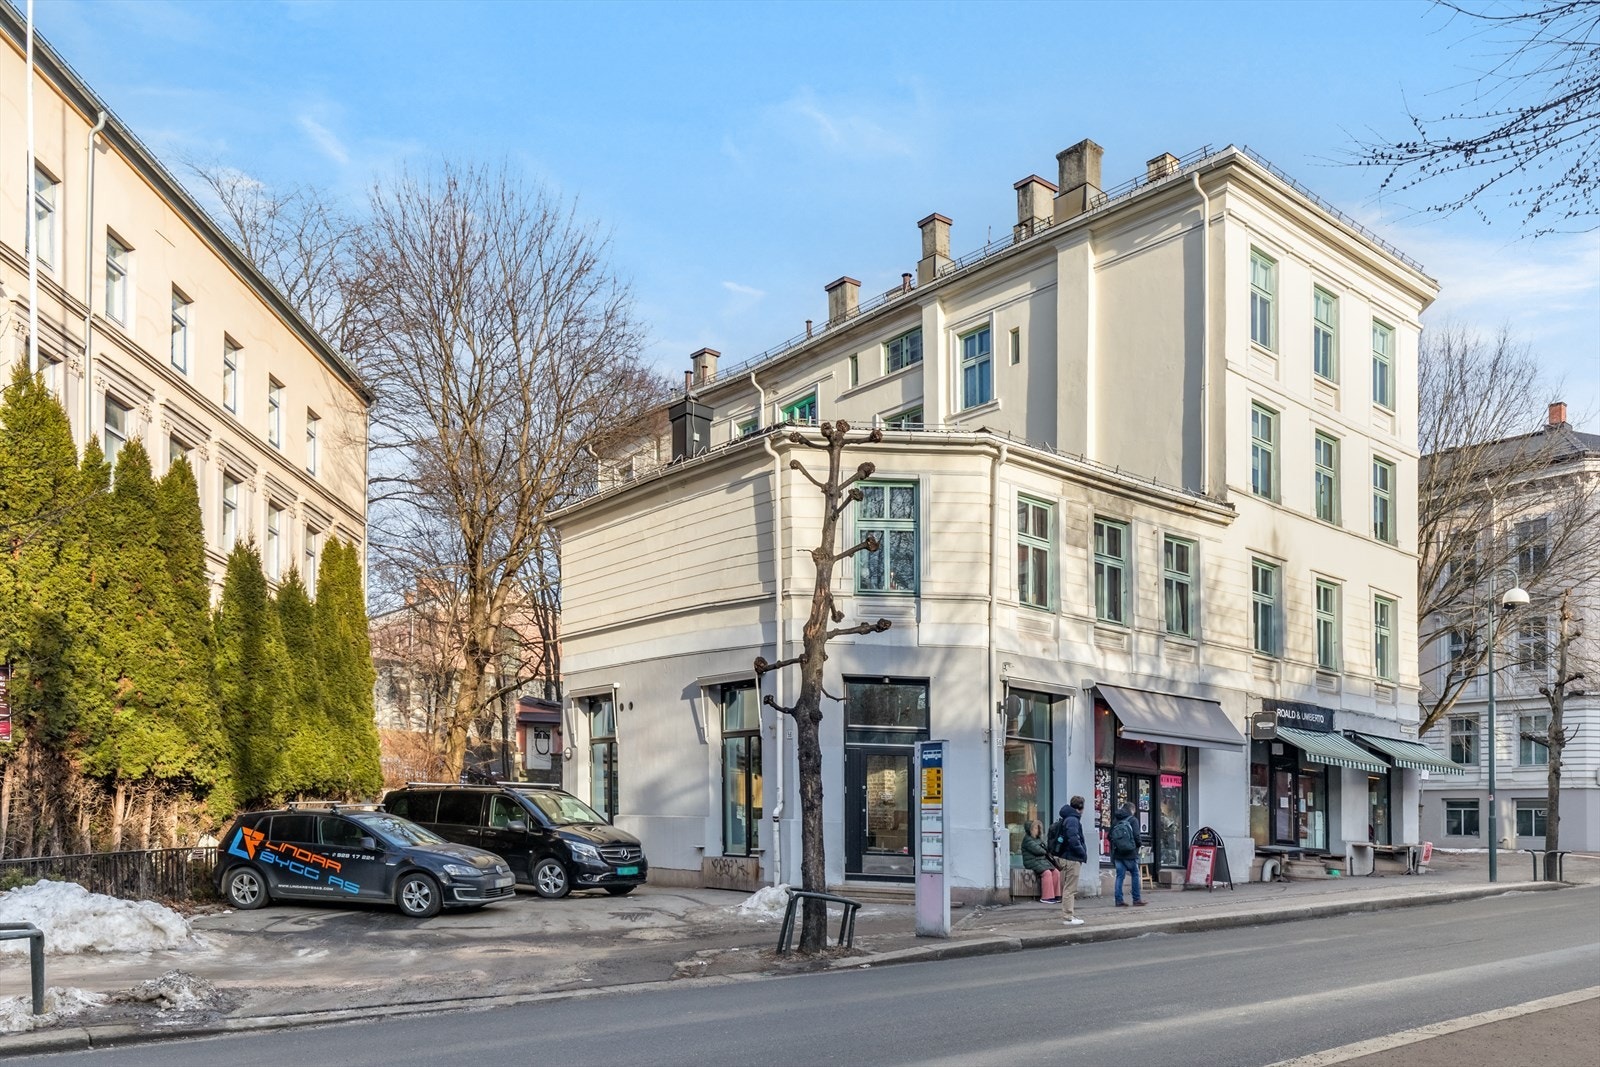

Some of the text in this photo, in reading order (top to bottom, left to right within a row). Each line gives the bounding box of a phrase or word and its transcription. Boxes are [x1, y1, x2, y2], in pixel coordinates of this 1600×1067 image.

[1276, 708, 1325, 724] ROALD & UMBERTO
[259, 850, 360, 894] BYGG AS
[265, 841, 342, 873] LINDAR
